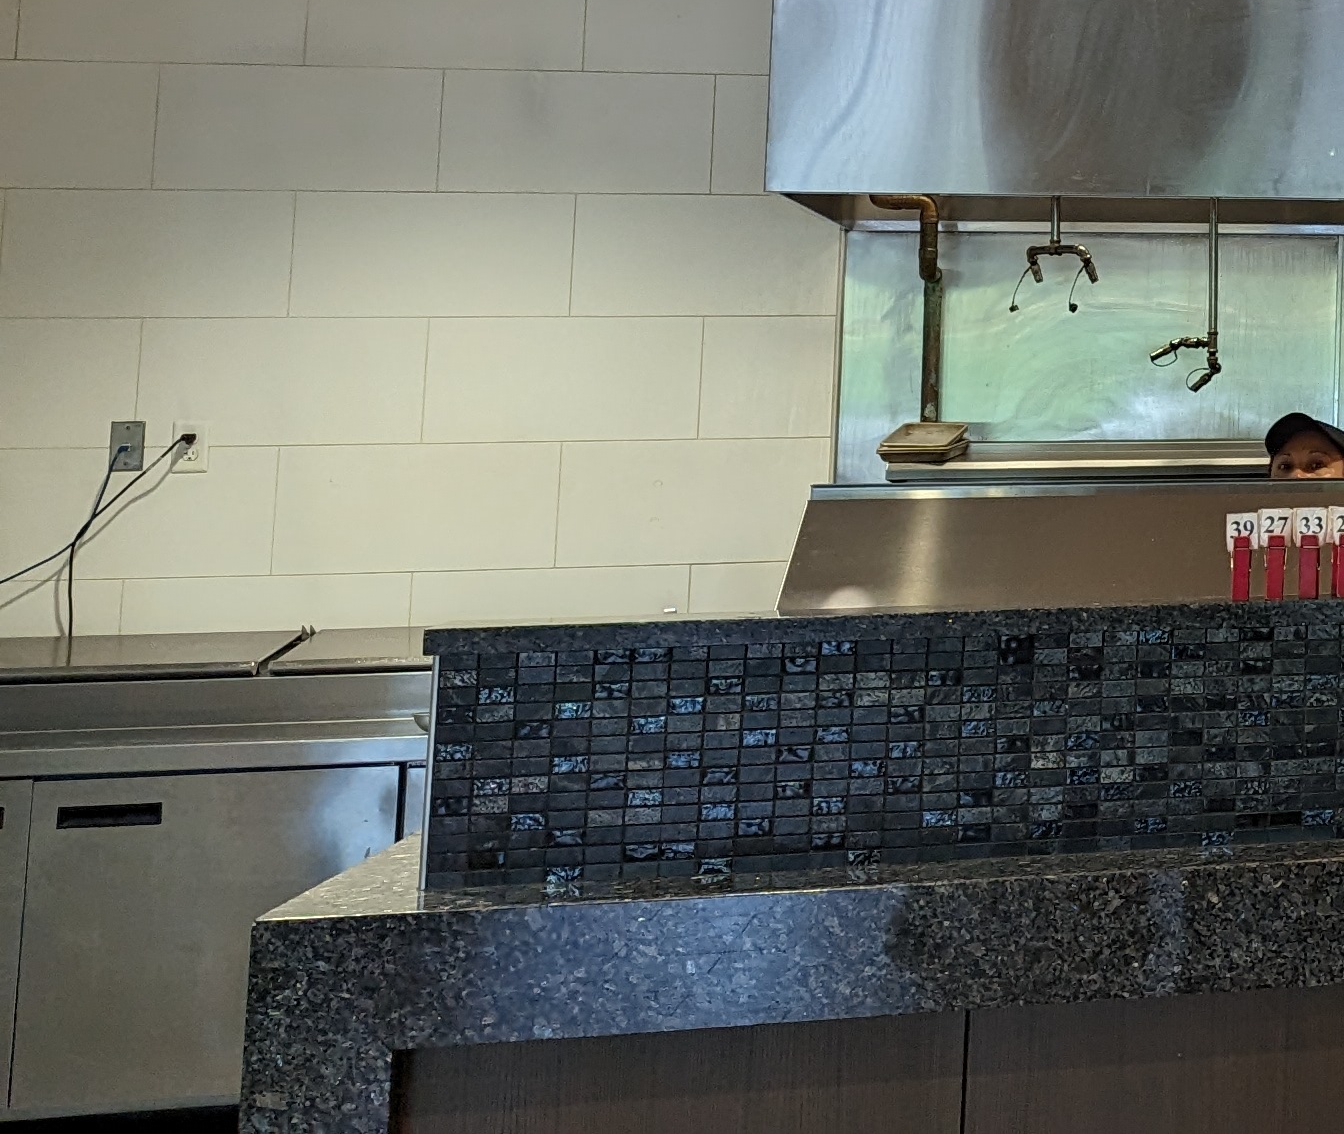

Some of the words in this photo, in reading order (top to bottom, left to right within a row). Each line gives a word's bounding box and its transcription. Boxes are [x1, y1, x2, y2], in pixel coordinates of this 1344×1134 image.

[1230, 519, 1255, 537] 39
[1262, 515, 1290, 534] 27
[1299, 516, 1324, 535] 33
